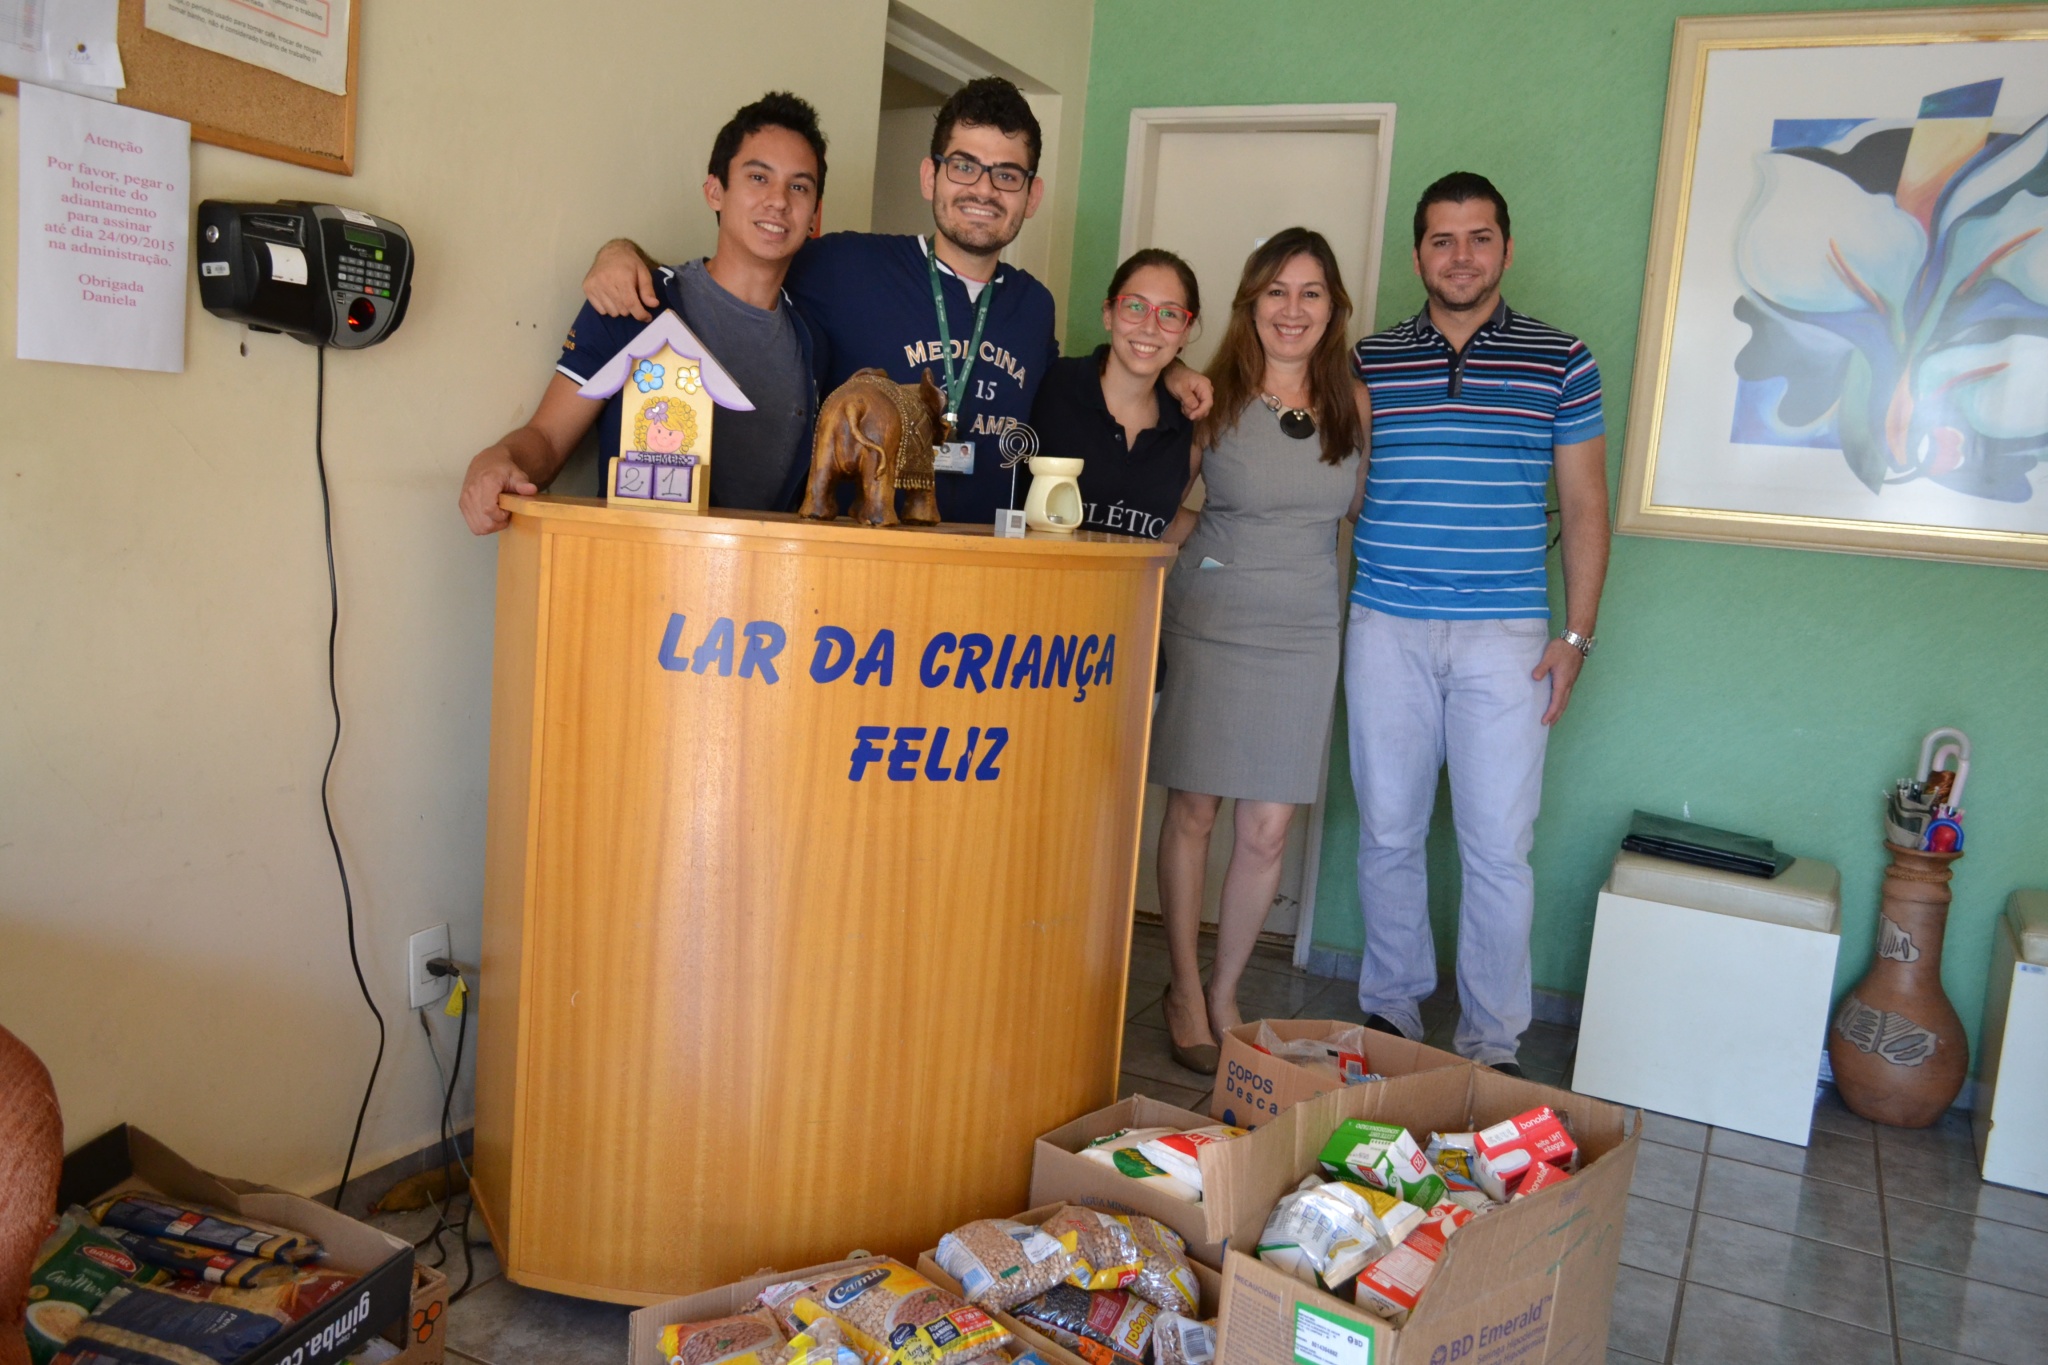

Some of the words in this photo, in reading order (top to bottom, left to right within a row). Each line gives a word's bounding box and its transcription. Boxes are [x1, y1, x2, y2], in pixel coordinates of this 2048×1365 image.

[300, 8, 323, 20] trabalho
[168, 3, 187, 16] tomar
[225, 26, 259, 42] considerado
[288, 49, 312, 62] trabalho
[214, 12, 232, 22] usado
[234, 19, 246, 28] para
[247, 24, 264, 34] tomar
[278, 36, 294, 46] trocar
[84, 132, 144, 154] Atenção
[47, 156, 74, 172] Por
[78, 162, 120, 182] favor,
[124, 174, 163, 190] pegar
[166, 182, 175, 192] o
[71, 176, 126, 198] holerite
[130, 189, 148, 202] do
[61, 192, 156, 219] adiantamento
[67, 211, 98, 224] para
[103, 216, 152, 233] assinar
[44, 222, 67, 234] até
[71, 226, 93, 239] dia
[98, 229, 176, 252] 24/09/2015
[48, 240, 66, 250] na
[70, 242, 172, 267] administração.
[78, 273, 144, 293] Obrigada
[82, 289, 137, 307] Daniela
[904, 339, 1027, 390] MEDICINA
[1082, 500, 1171, 539] LÉTIC
[657, 612, 787, 686] LAR
[809, 625, 895, 688] DA
[919, 631, 1116, 703] CRIANÇA
[847, 725, 1009, 783] FELIZ
[1228, 1060, 1274, 1095] COPOS
[1519, 1107, 1552, 1130] bonolat
[1534, 1138, 1550, 1149] leite
[1548, 1130, 1562, 1142] UHT
[1544, 1140, 1566, 1154] integral
[834, 1268, 886, 1300] Camil
[274, 1291, 371, 1365] gimba.co
[1124, 1313, 1152, 1351] Legal
[1353, 1339, 1364, 1348] BD
[1451, 1334, 1474, 1363] BD
